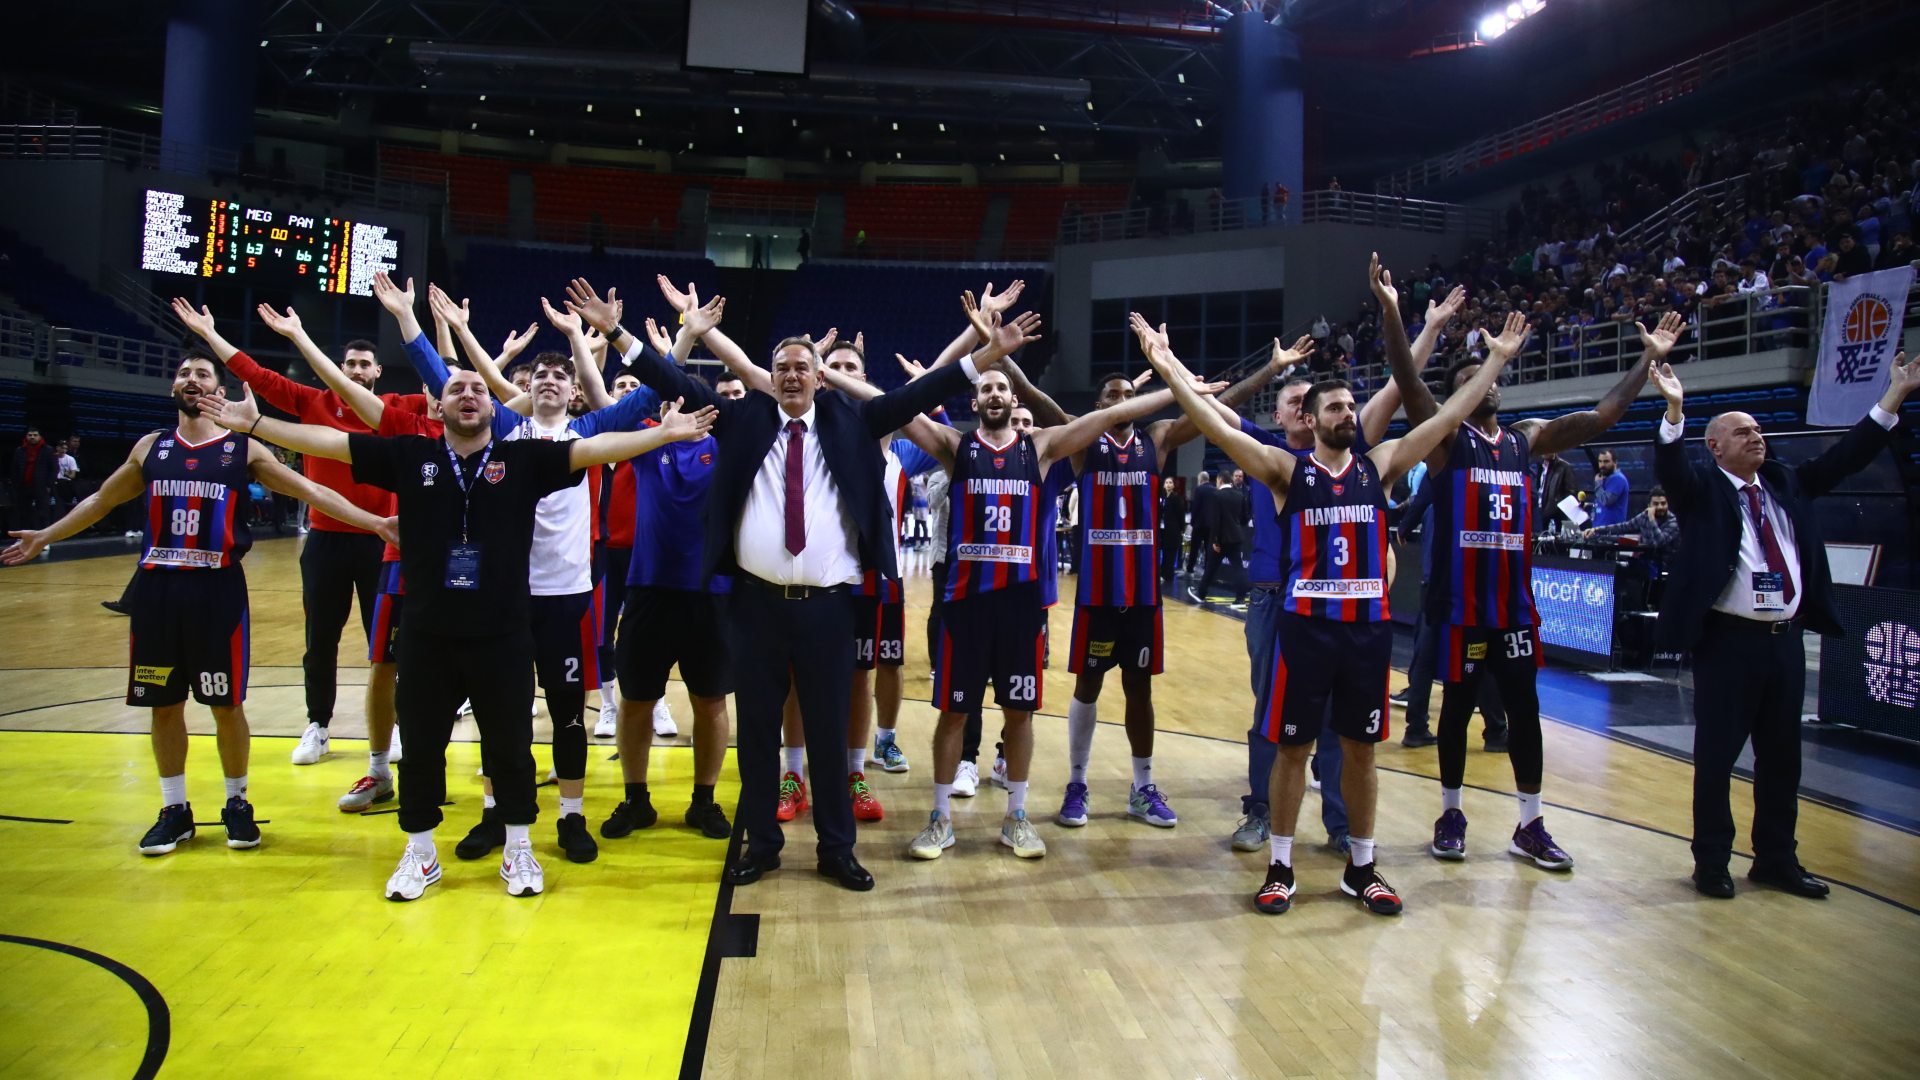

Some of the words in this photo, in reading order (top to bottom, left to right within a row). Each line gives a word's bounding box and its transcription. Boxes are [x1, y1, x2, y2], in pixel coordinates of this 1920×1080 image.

[246, 208, 272, 222] MEG
[288, 215, 314, 229] PAN
[246, 243, 263, 255] 63
[296, 250, 312, 262] 66
[248, 257, 256, 267] 5
[298, 264, 306, 274] 5
[152, 480, 226, 501] ΠΑΝΙΩΝΙΟΣ
[967, 478, 1029, 496] ΠΑΝΙΩΝΙΟΣ
[1119, 496, 1127, 520] 0
[1304, 504, 1374, 526] ΠΑΝΙΩΝΙΟΣ
[1489, 494, 1512, 521] 35
[171, 509, 200, 536] 88
[984, 506, 1011, 532] 28
[149, 549, 219, 562] osmorama
[960, 545, 1028, 557] cosmorama
[1334, 537, 1348, 566] 3
[1297, 581, 1379, 591] cosmorama
[1533, 574, 1581, 603] nicef
[855, 638, 873, 661] 14
[880, 640, 902, 660] 33
[1504, 630, 1532, 659] 35
[1138, 646, 1150, 668] 0
[564, 658, 579, 682] 2
[200, 672, 228, 696] 88
[1009, 675, 1036, 700] 28
[1366, 709, 1380, 734] 3
